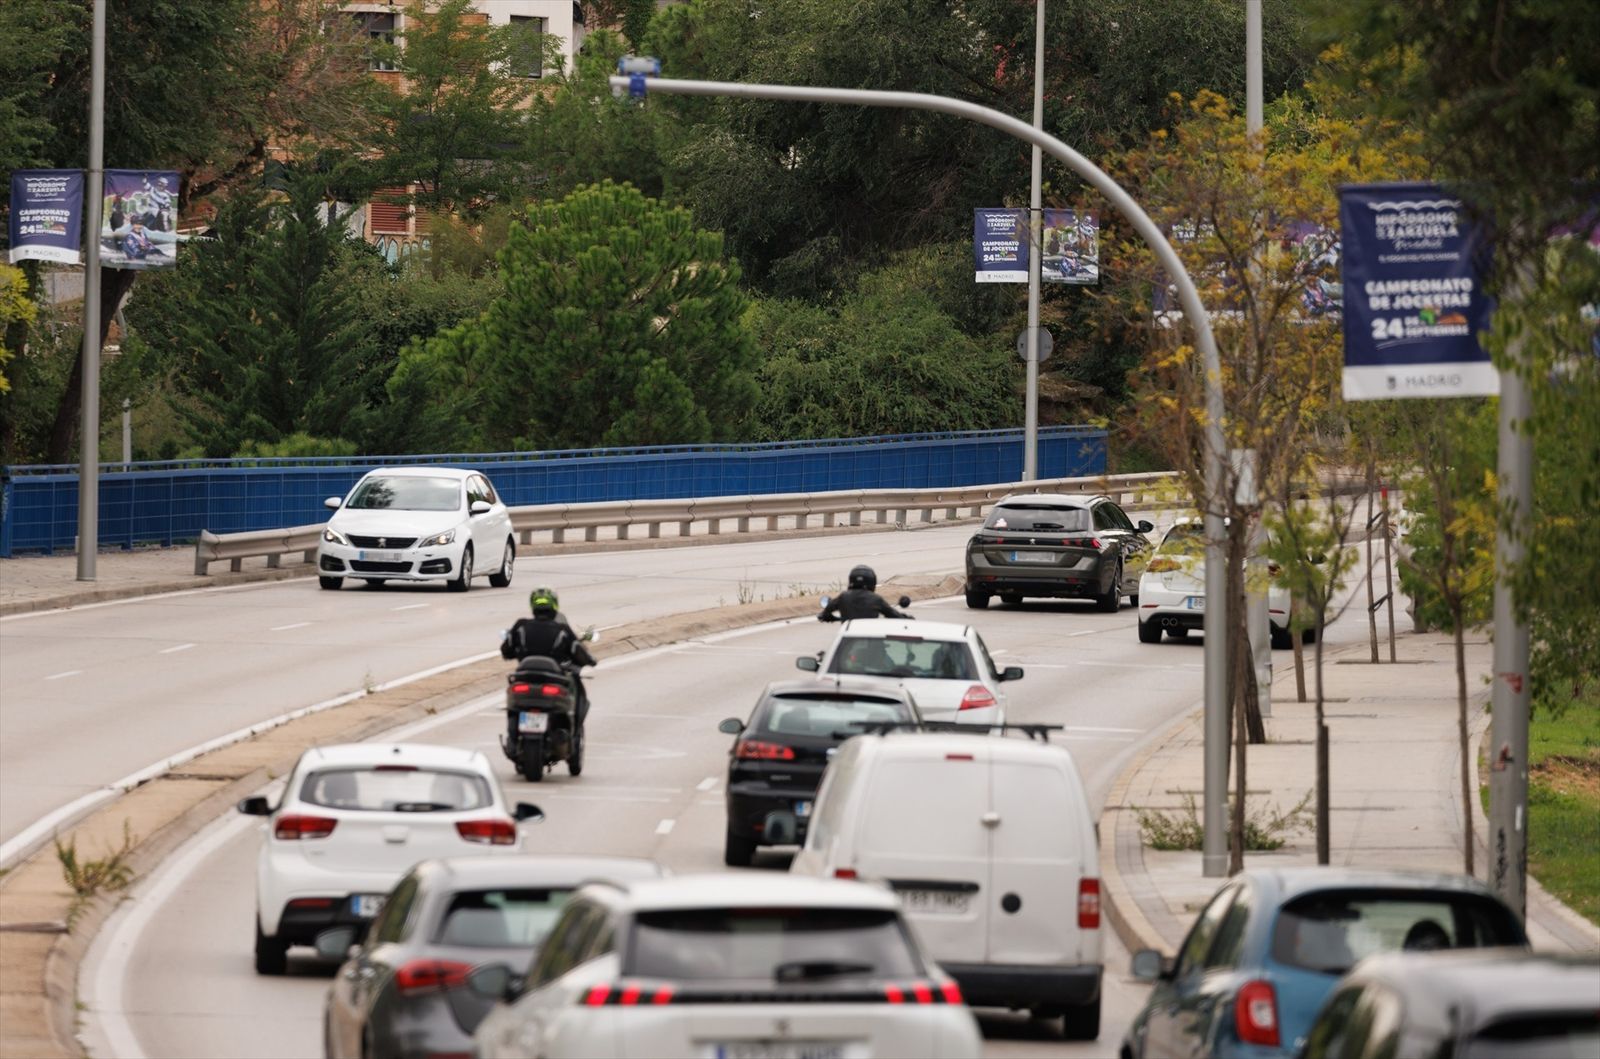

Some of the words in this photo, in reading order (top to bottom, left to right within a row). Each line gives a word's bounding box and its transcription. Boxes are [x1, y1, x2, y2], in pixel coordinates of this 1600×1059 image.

[1375, 211, 1457, 224] HIPÓDROMO
[20, 225, 35, 234] 24
[1387, 224, 1459, 237] ZARZUELA
[33, 249, 61, 257] MADRID
[1365, 278, 1472, 294] CAMPEONATO
[1369, 295, 1390, 309] DE
[1392, 293, 1470, 309] JOCKETAS
[1371, 317, 1403, 339] 24
[1405, 324, 1469, 337] SEPTIEMBRE
[1406, 374, 1461, 386] MADRID
